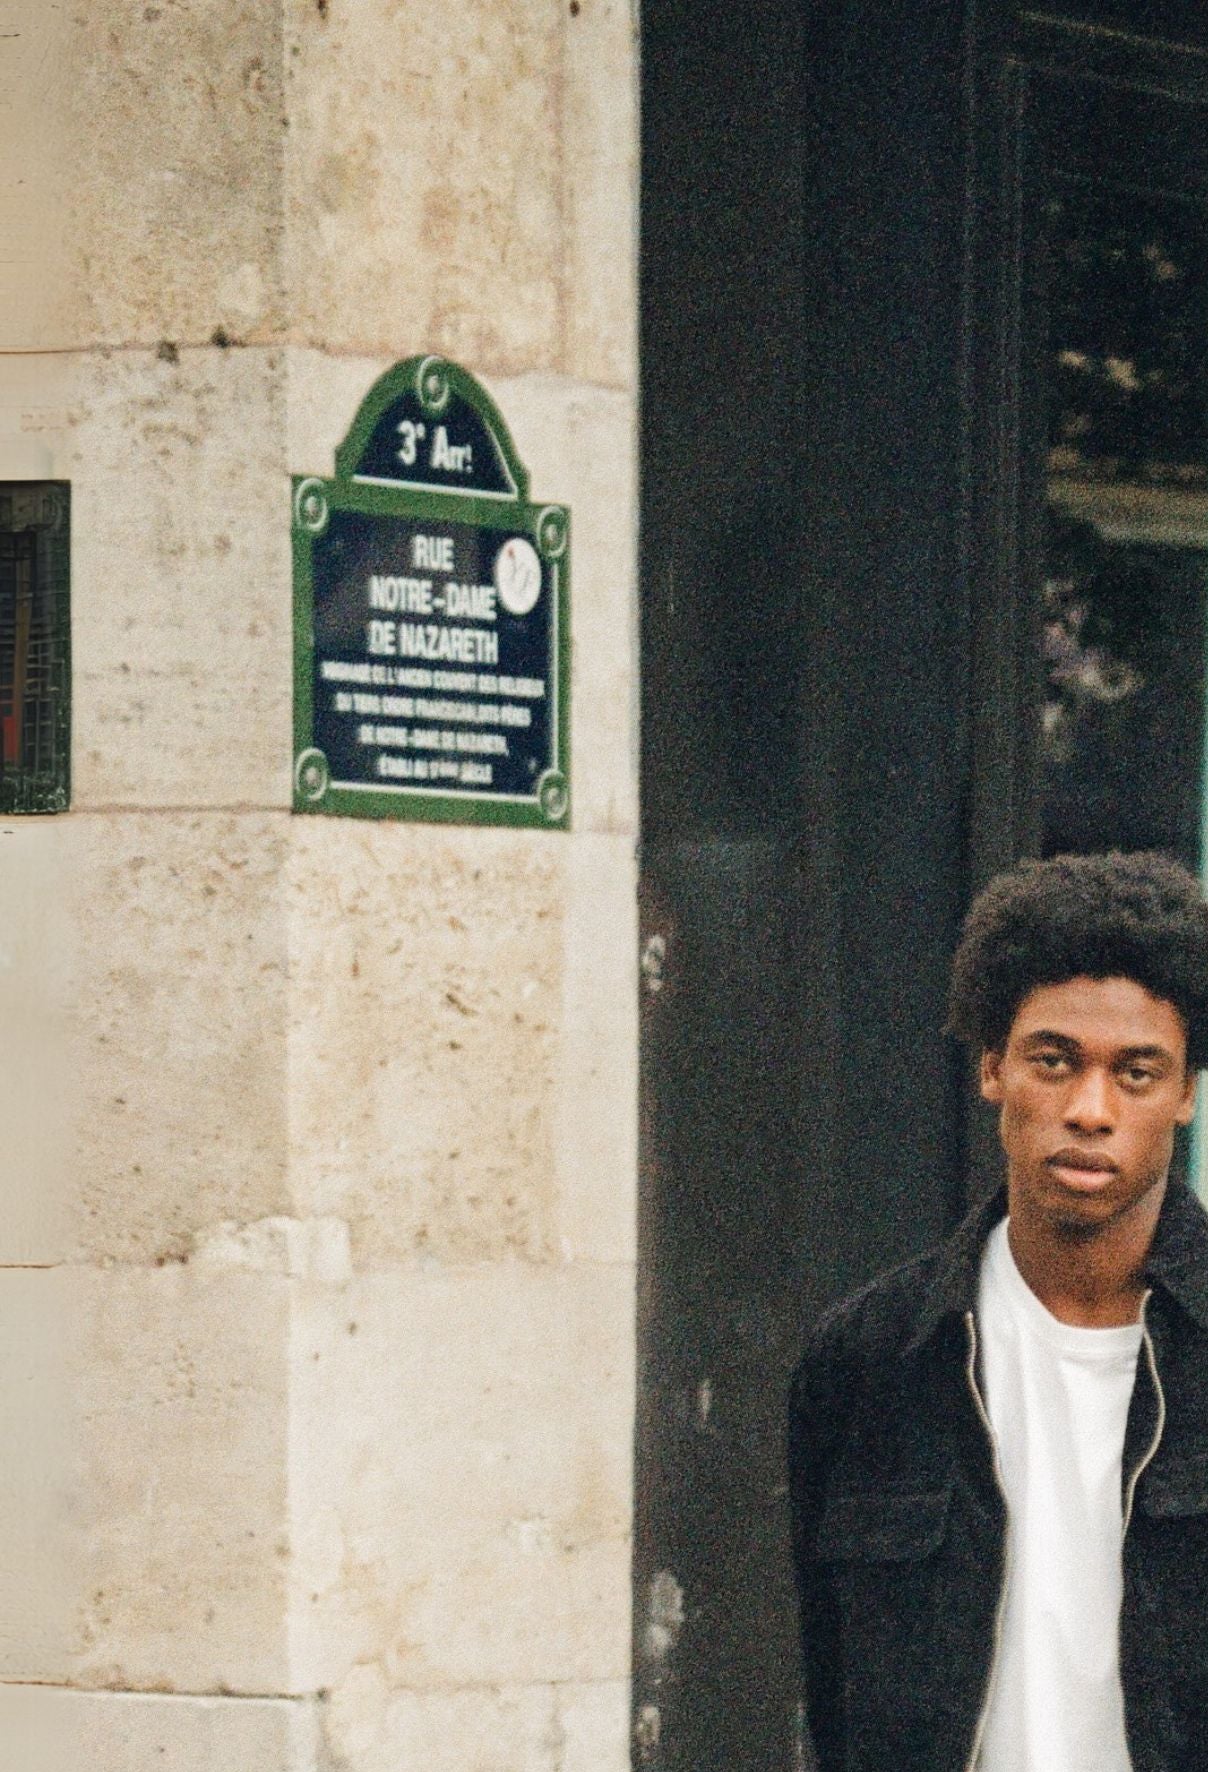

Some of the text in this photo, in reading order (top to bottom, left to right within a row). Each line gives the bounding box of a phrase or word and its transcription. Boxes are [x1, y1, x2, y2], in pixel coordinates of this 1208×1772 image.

[412, 534, 455, 571] RUE
[369, 575, 497, 620] NOTRE-DAME
[369, 620, 498, 664] DE NAZARETH
